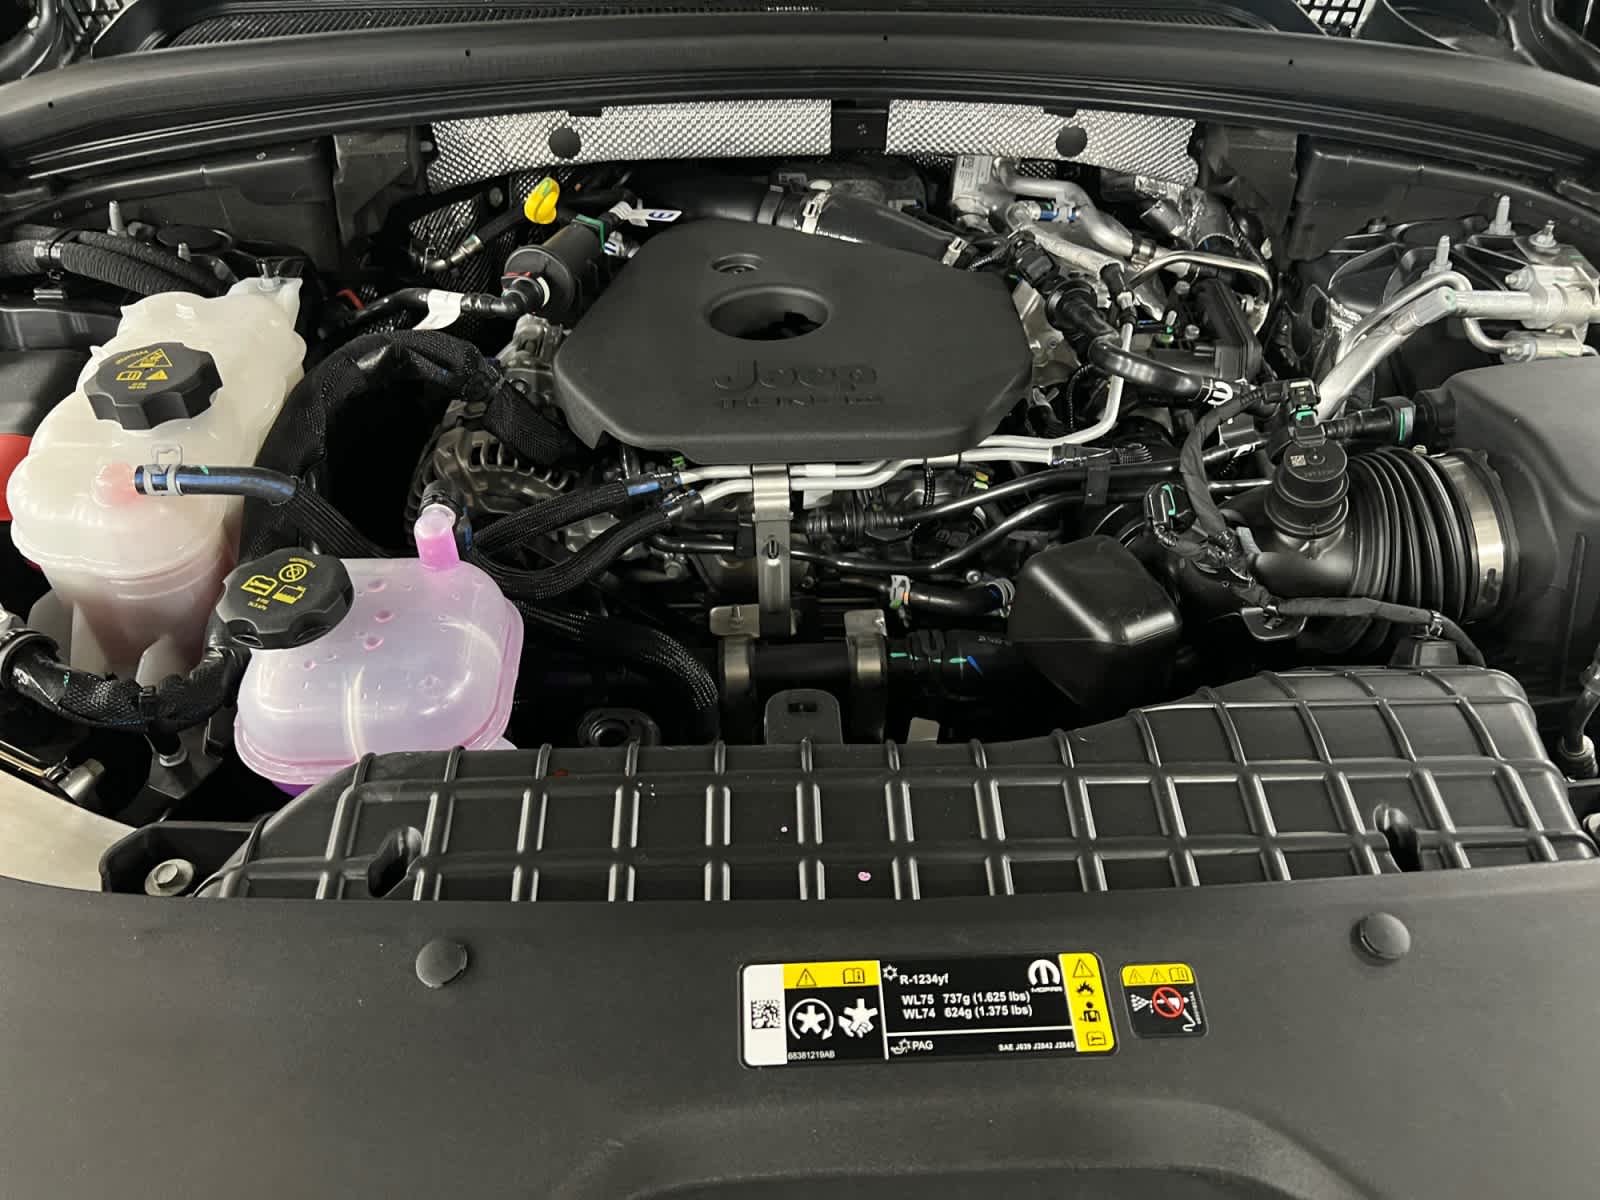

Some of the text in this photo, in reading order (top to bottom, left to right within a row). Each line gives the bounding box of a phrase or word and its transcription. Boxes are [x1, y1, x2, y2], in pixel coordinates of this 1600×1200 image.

[712, 359, 878, 393] Jeep
[899, 973, 949, 987] R-1234yf
[901, 991, 1031, 1005] WL75 737g (1.625 lbs)
[903, 1004, 1033, 1020] WL74 624g (1.375 lbs)
[911, 1039, 934, 1051] PAG
